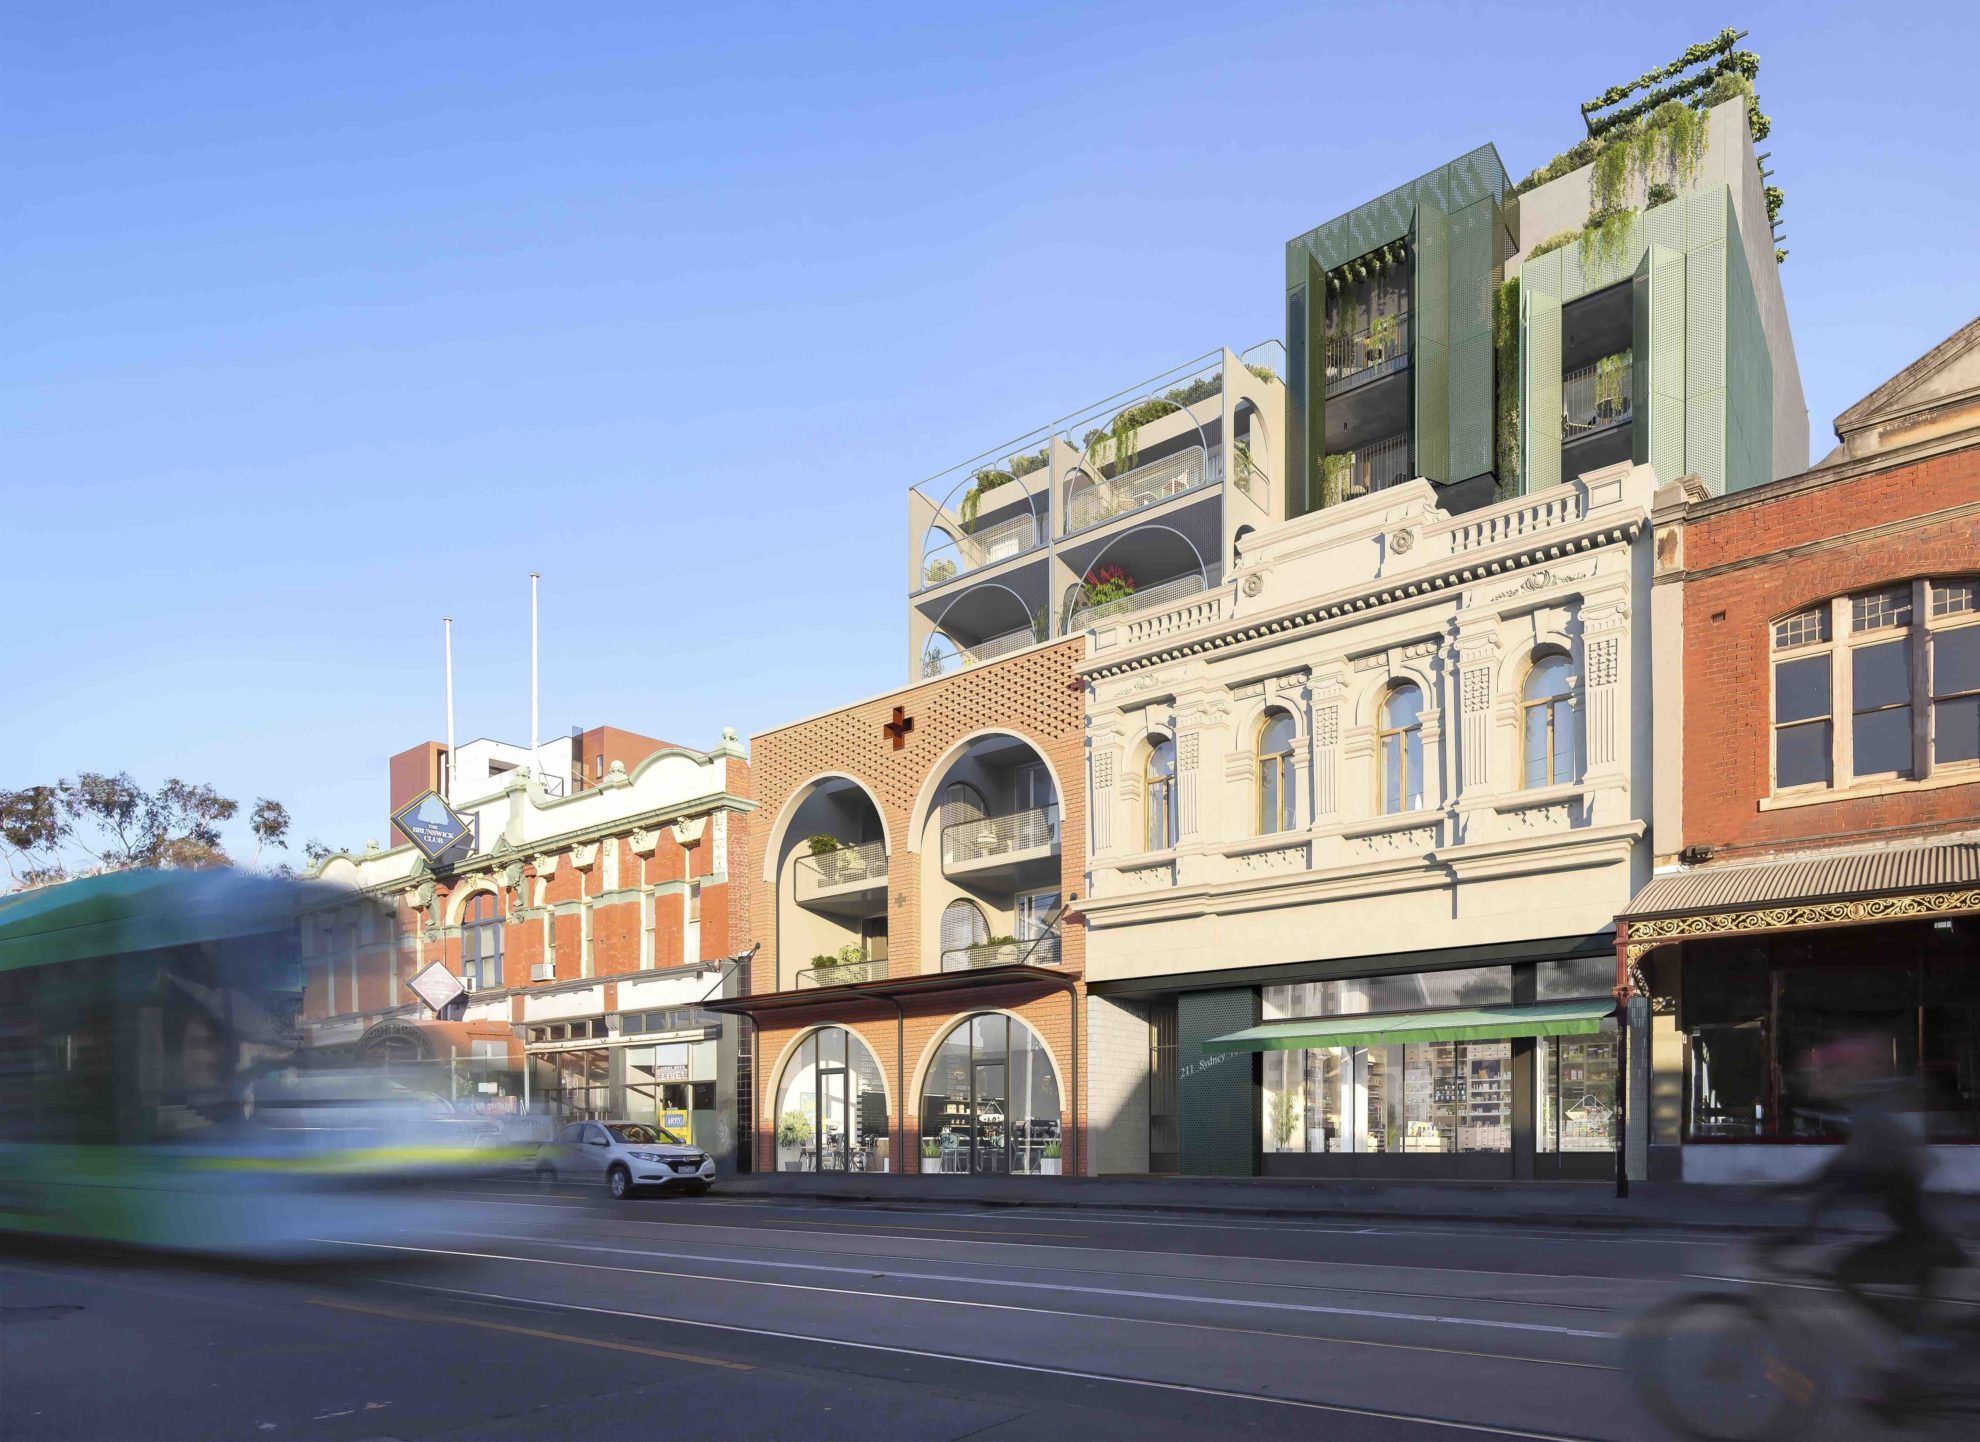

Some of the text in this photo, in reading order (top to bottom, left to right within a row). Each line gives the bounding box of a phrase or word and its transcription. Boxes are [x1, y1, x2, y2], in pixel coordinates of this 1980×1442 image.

[413, 827, 454, 838] BRUNSWICK
[424, 835, 443, 843] CLUB
[1199, 1053, 1226, 1071] Sydney
